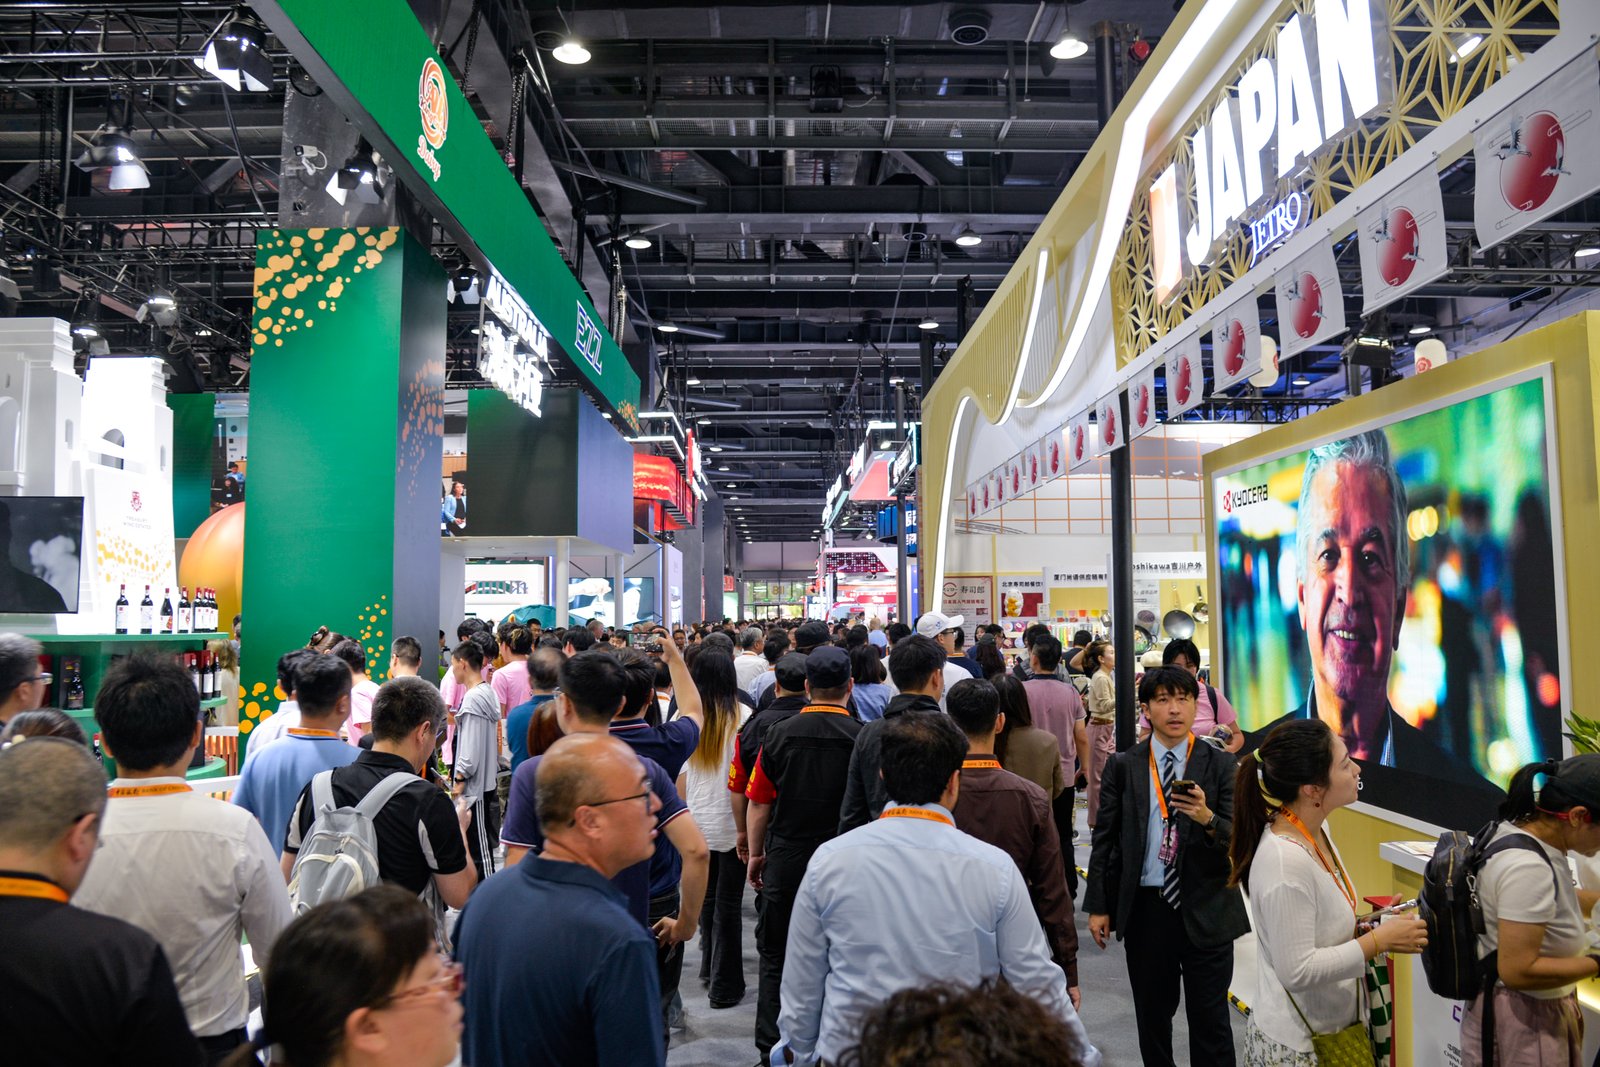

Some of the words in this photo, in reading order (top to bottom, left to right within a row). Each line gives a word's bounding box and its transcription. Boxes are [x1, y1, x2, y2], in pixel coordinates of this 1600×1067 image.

[1186, 0, 1379, 266] JAPAN
[1249, 192, 1302, 268] JETRO
[486, 275, 549, 363] AUSTRALIA
[1231, 484, 1268, 508] KYOCERA
